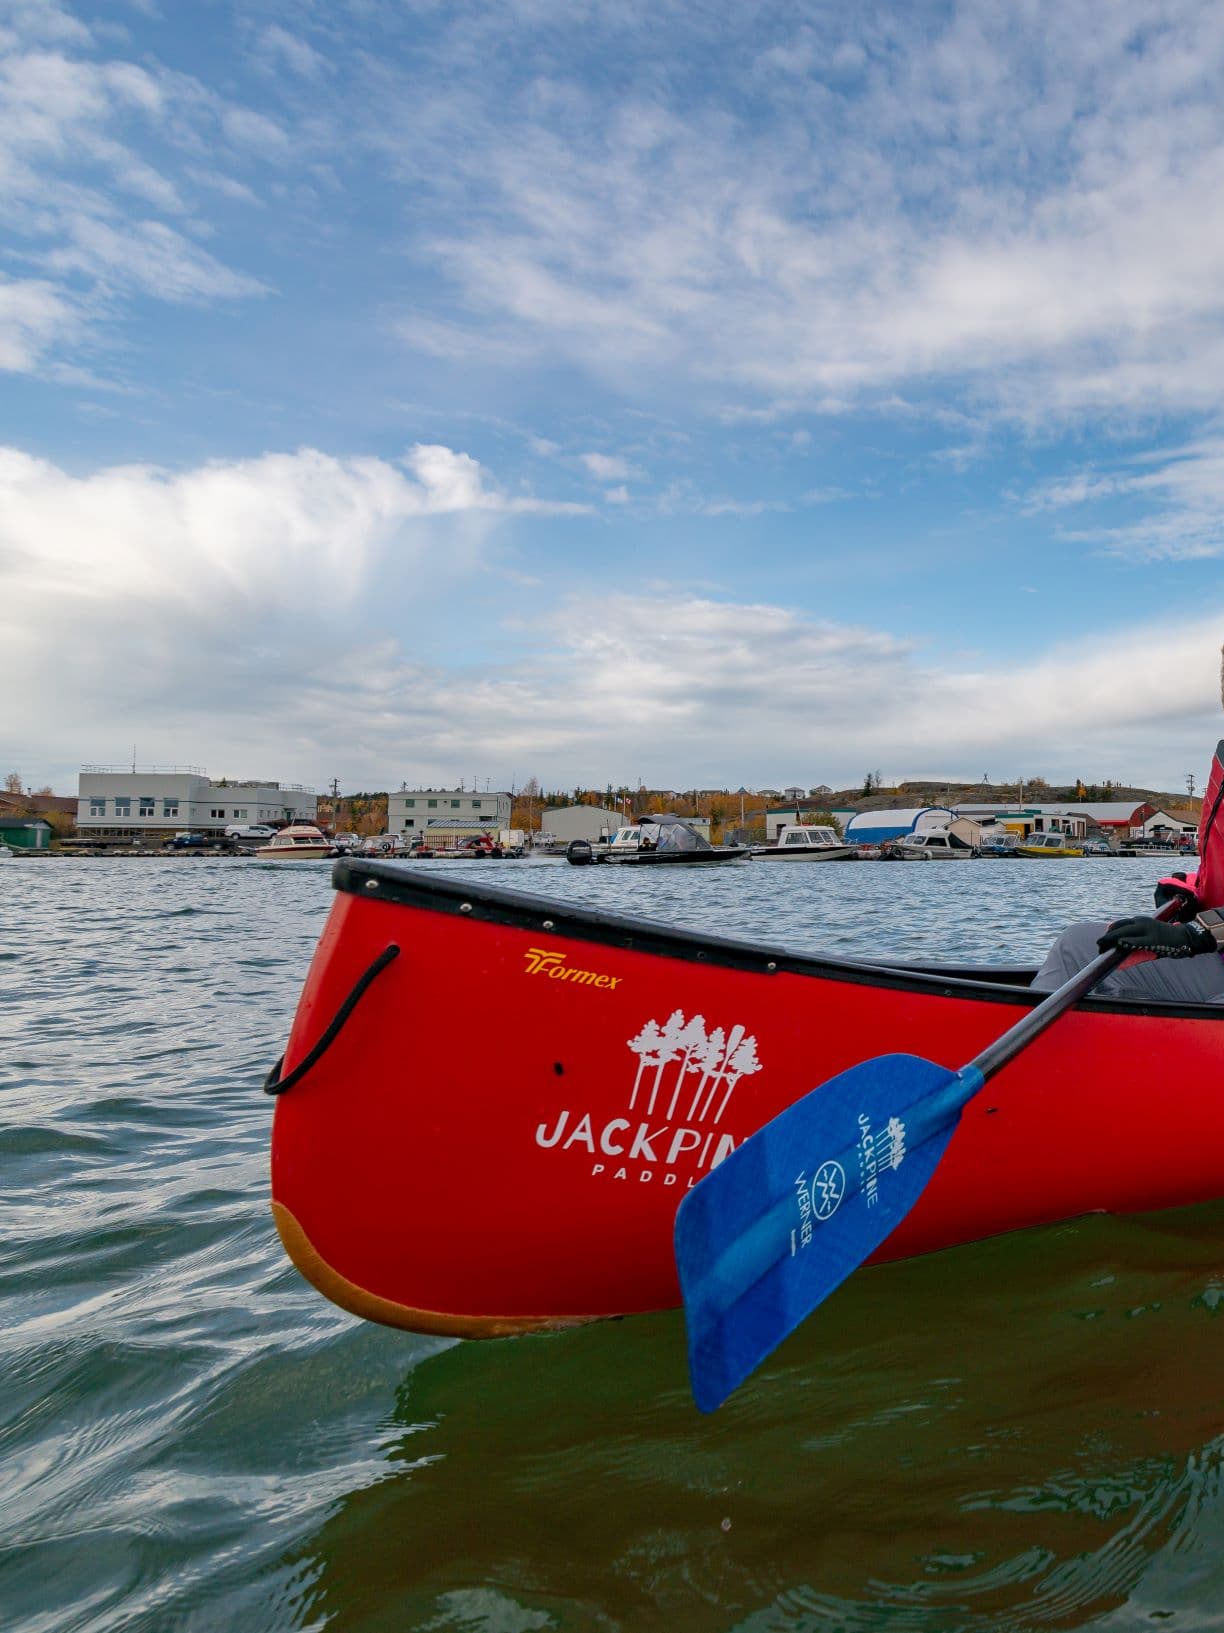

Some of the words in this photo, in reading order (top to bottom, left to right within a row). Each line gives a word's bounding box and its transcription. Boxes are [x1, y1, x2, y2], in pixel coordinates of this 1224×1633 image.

[535, 1110, 750, 1170] JACKPIN
[858, 1113, 878, 1209] JACKPINE
[592, 1164, 696, 1189] PADDL
[794, 1170, 813, 1249] WERNER
